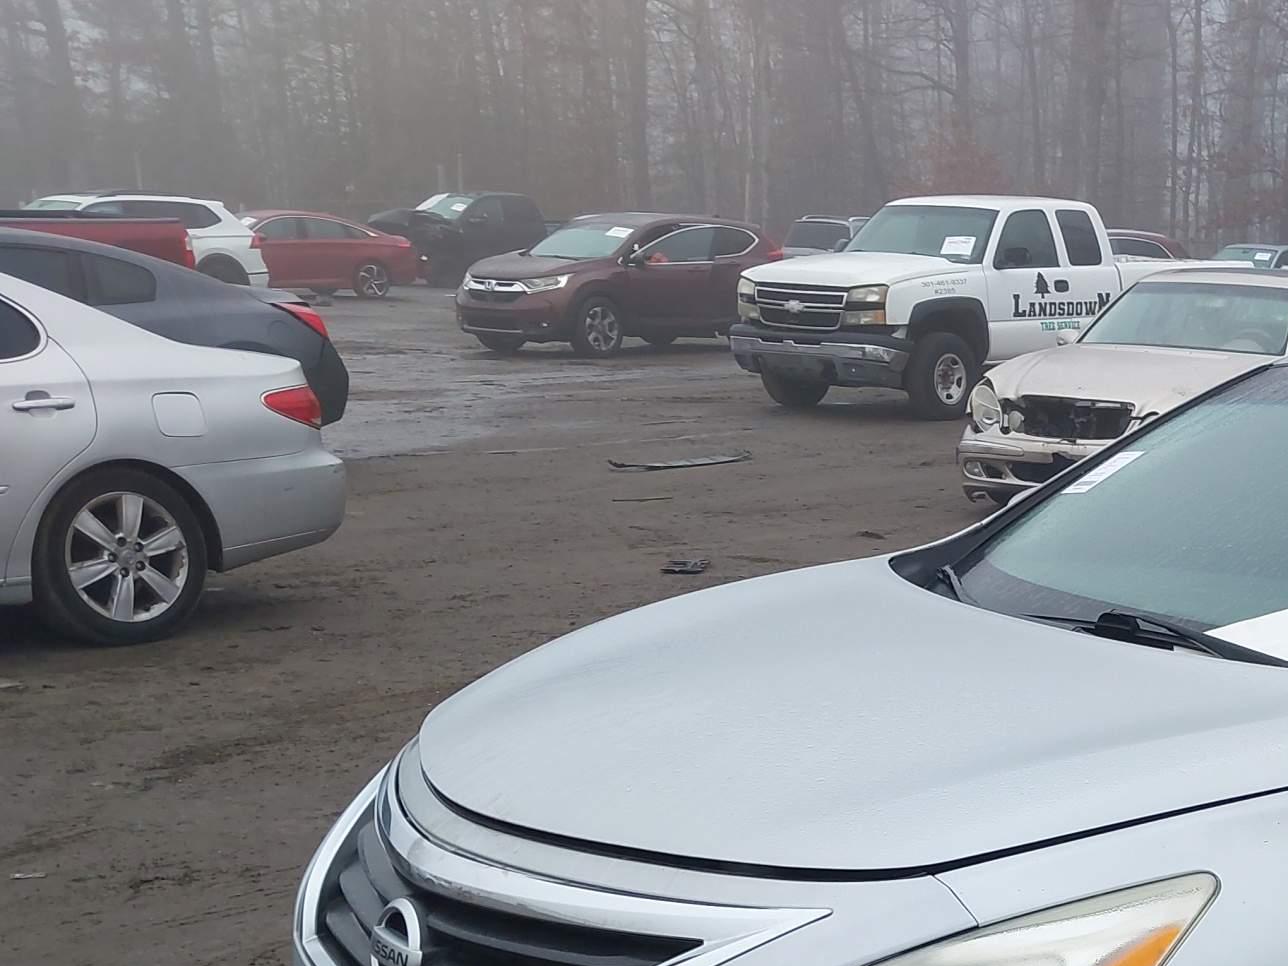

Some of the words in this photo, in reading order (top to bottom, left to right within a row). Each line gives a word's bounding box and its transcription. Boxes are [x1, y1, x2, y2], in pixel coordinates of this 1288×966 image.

[1012, 292, 1111, 318] LANDSDOWN
[1040, 321, 1056, 331] TREE
[1057, 320, 1081, 330] SERVICE
